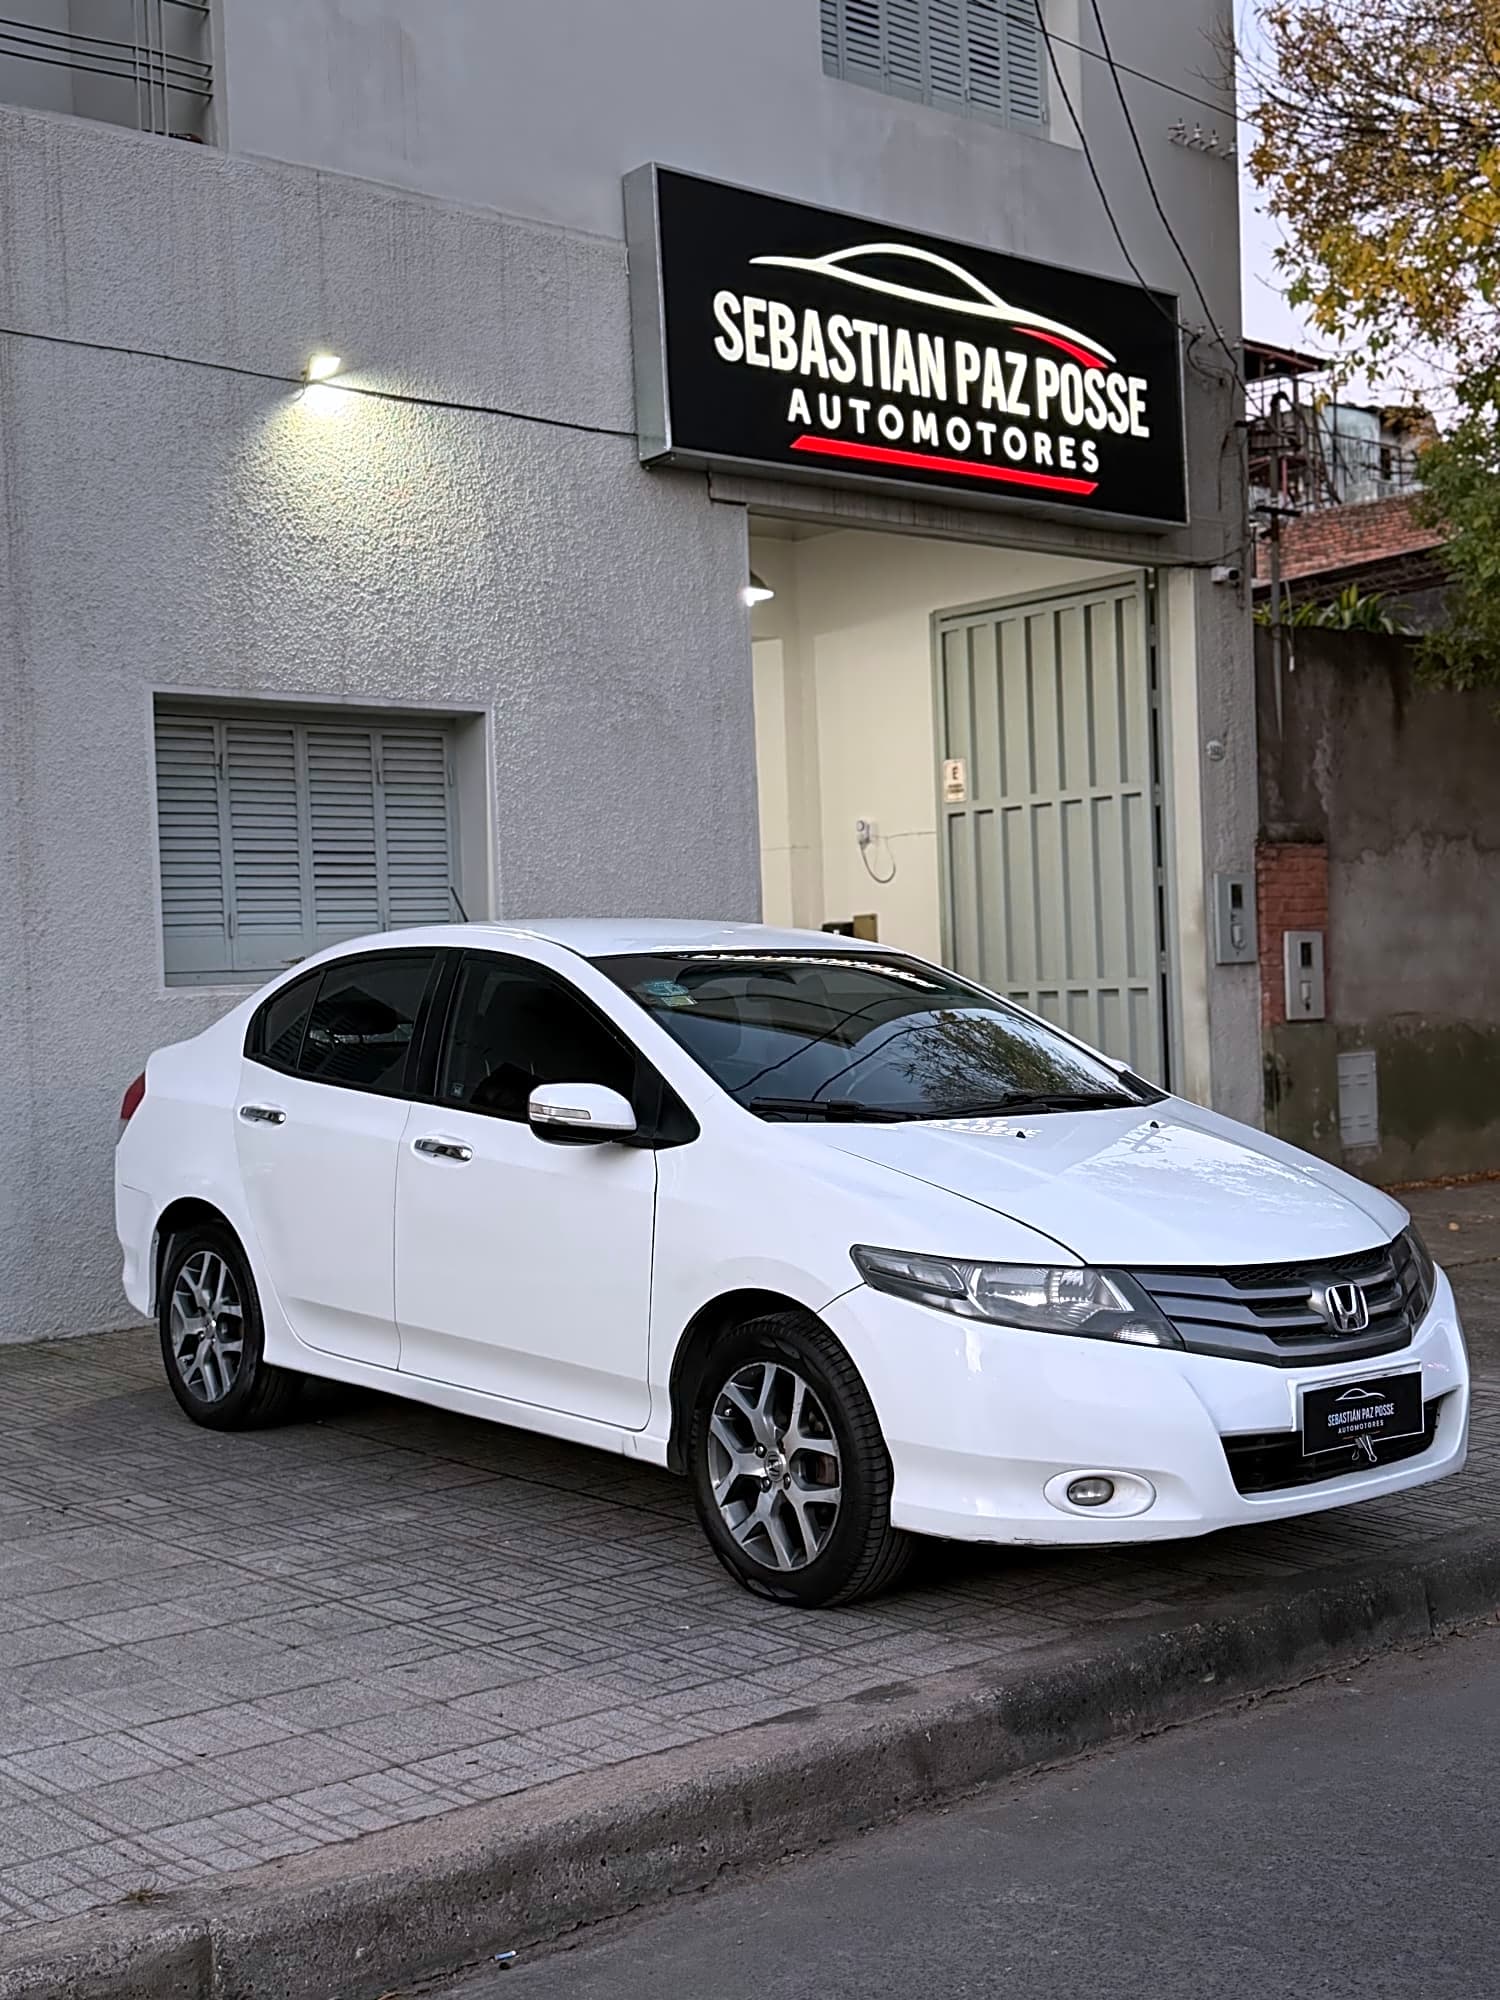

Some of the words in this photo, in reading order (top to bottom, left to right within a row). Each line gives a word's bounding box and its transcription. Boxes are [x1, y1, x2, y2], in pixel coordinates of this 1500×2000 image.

[713, 290, 947, 401] SEBASTIAN
[954, 340, 1031, 417] PAZ
[1035, 358, 1150, 438] POSSE
[787, 388, 1099, 473] AUTOMOTORES
[1338, 1420, 1385, 1434] AUTOMOTORES
[1362, 1407, 1375, 1420] PAZ
[1375, 1403, 1395, 1417] POSSE
